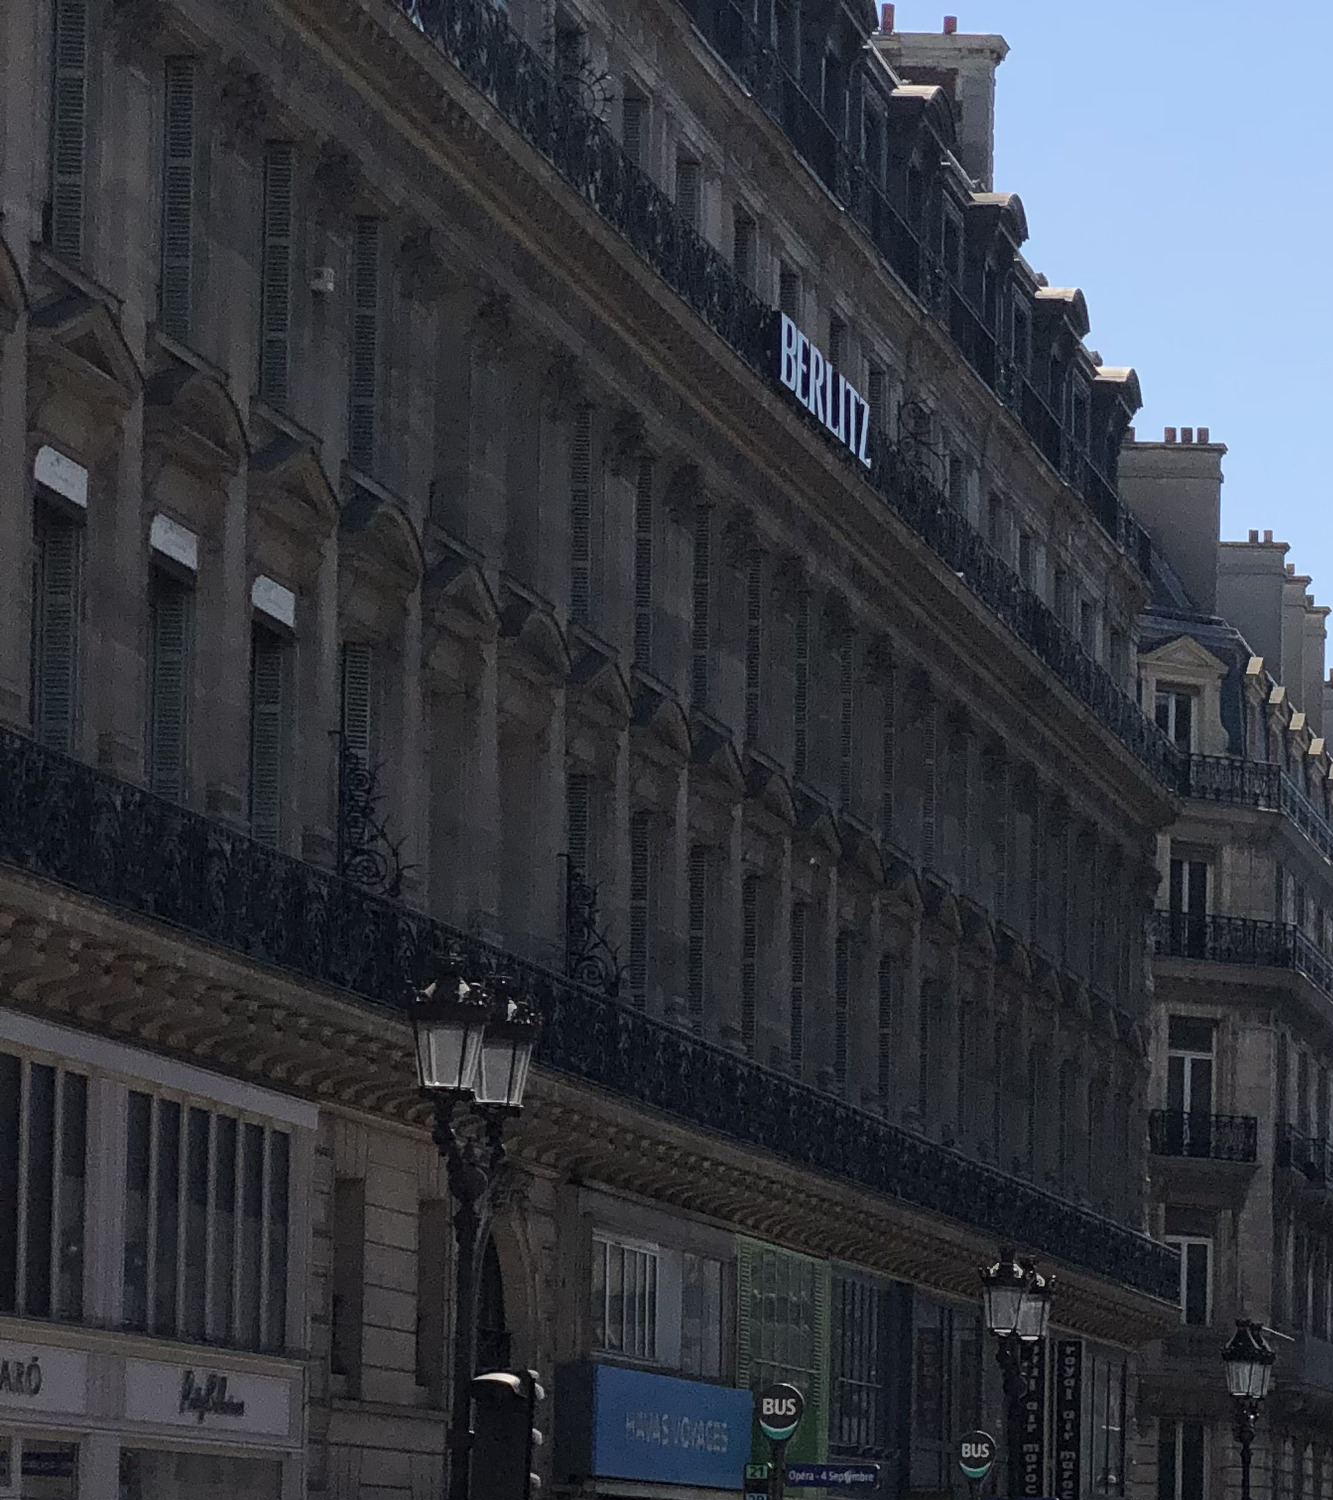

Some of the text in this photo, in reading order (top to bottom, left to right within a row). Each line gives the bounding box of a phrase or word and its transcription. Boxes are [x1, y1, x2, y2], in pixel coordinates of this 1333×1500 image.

[780, 312, 871, 469] BERLITZ
[762, 1398, 797, 1416] BUS
[961, 1443, 990, 1458] BUS
[749, 1466, 765, 1479] 21
[788, 1469, 814, 1484] Opéra
[820, 1470, 828, 1481] 4
[1060, 1451, 1077, 1500] maroc
